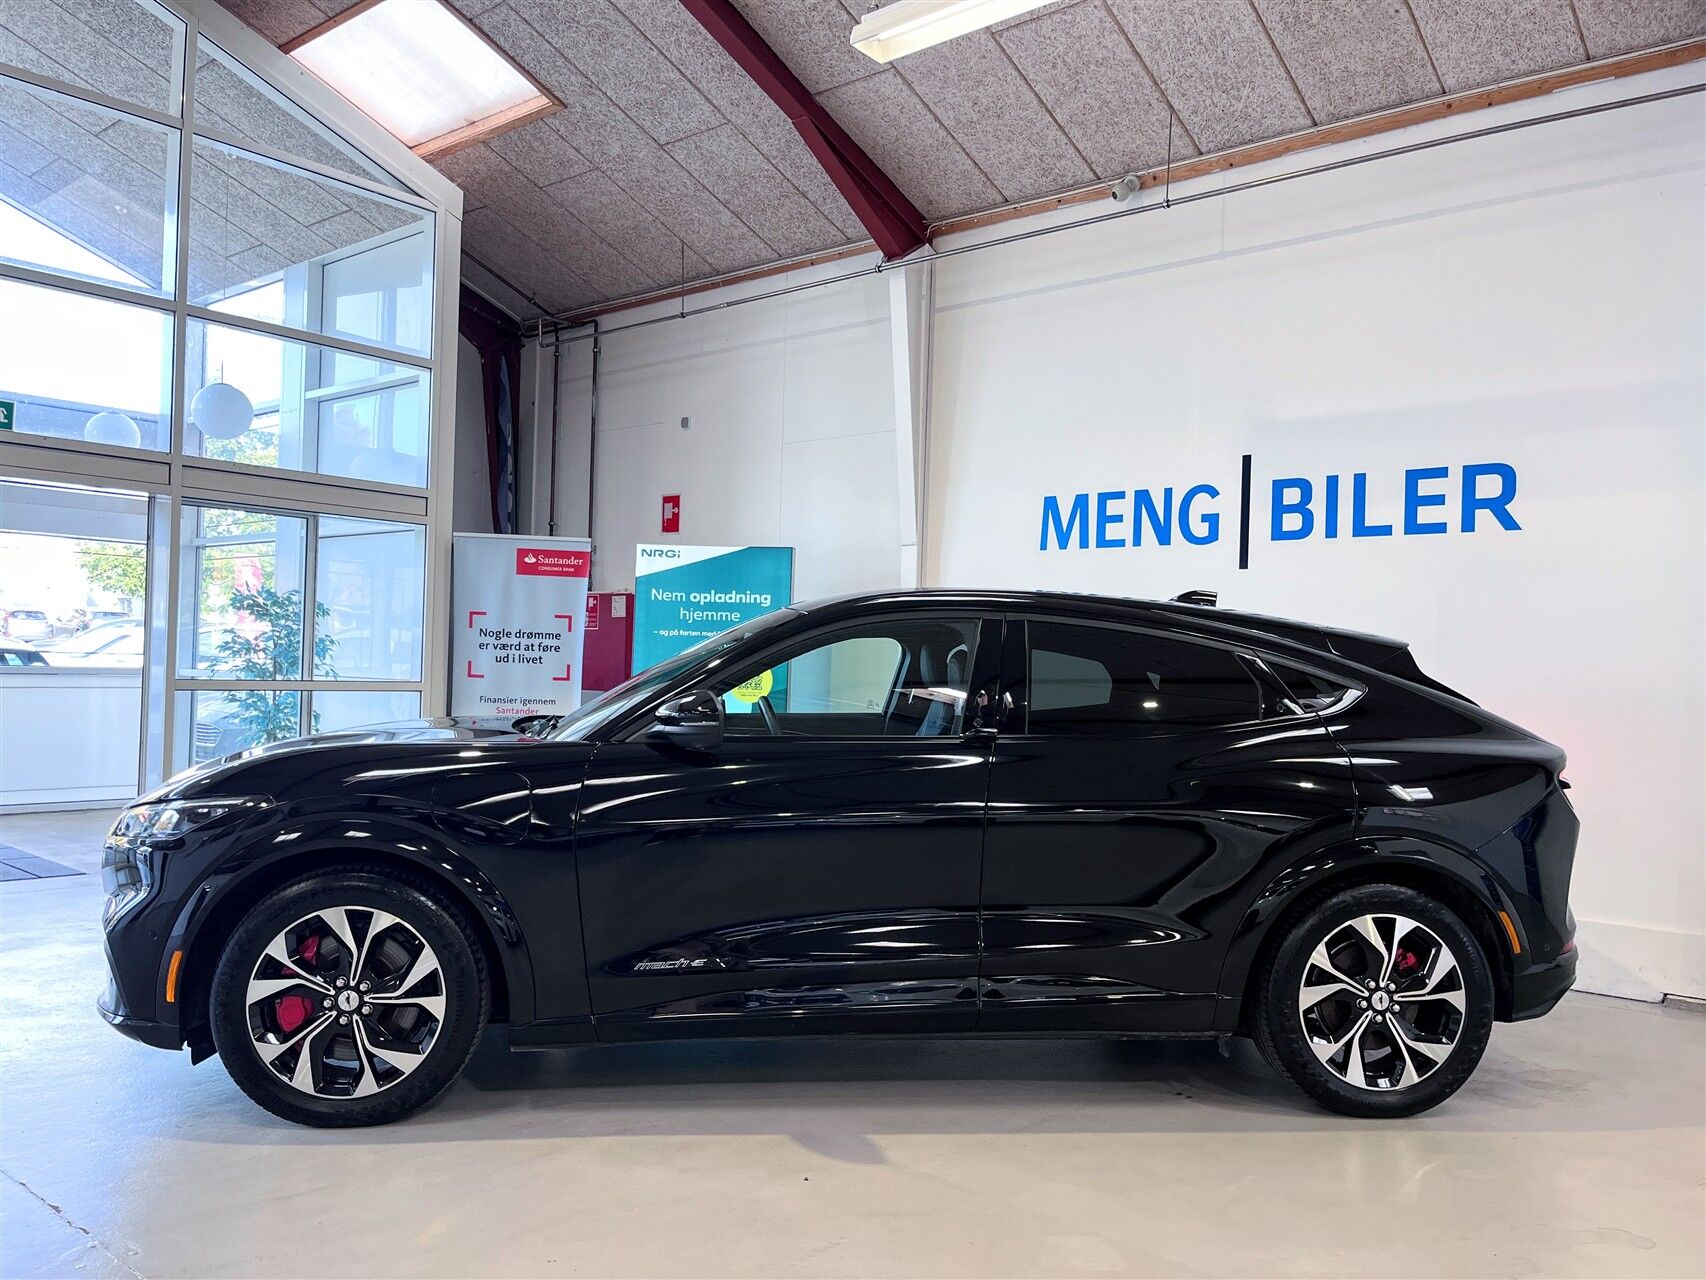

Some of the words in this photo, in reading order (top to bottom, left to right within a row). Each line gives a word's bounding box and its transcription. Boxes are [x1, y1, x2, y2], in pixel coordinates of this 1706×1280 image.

[1040, 484, 1220, 551] MENG
[1270, 462, 1523, 542] BILER
[538, 554, 584, 566] Santander
[651, 588, 686, 602] Nem
[689, 589, 771, 607] opladning
[680, 607, 741, 624] hjemme
[479, 628, 512, 640] Nogle
[514, 628, 562, 641] drømme
[659, 629, 669, 637] og
[669, 628, 679, 637] på
[478, 642, 490, 651] er
[493, 641, 521, 652] værd
[523, 643, 535, 652] at
[538, 642, 561, 653] føre
[495, 653, 509, 663] ud
[512, 654, 516, 664] i
[518, 654, 544, 665] livet
[479, 695, 518, 705] Finansier
[519, 696, 557, 707] igennem
[495, 706, 539, 716] Santander
